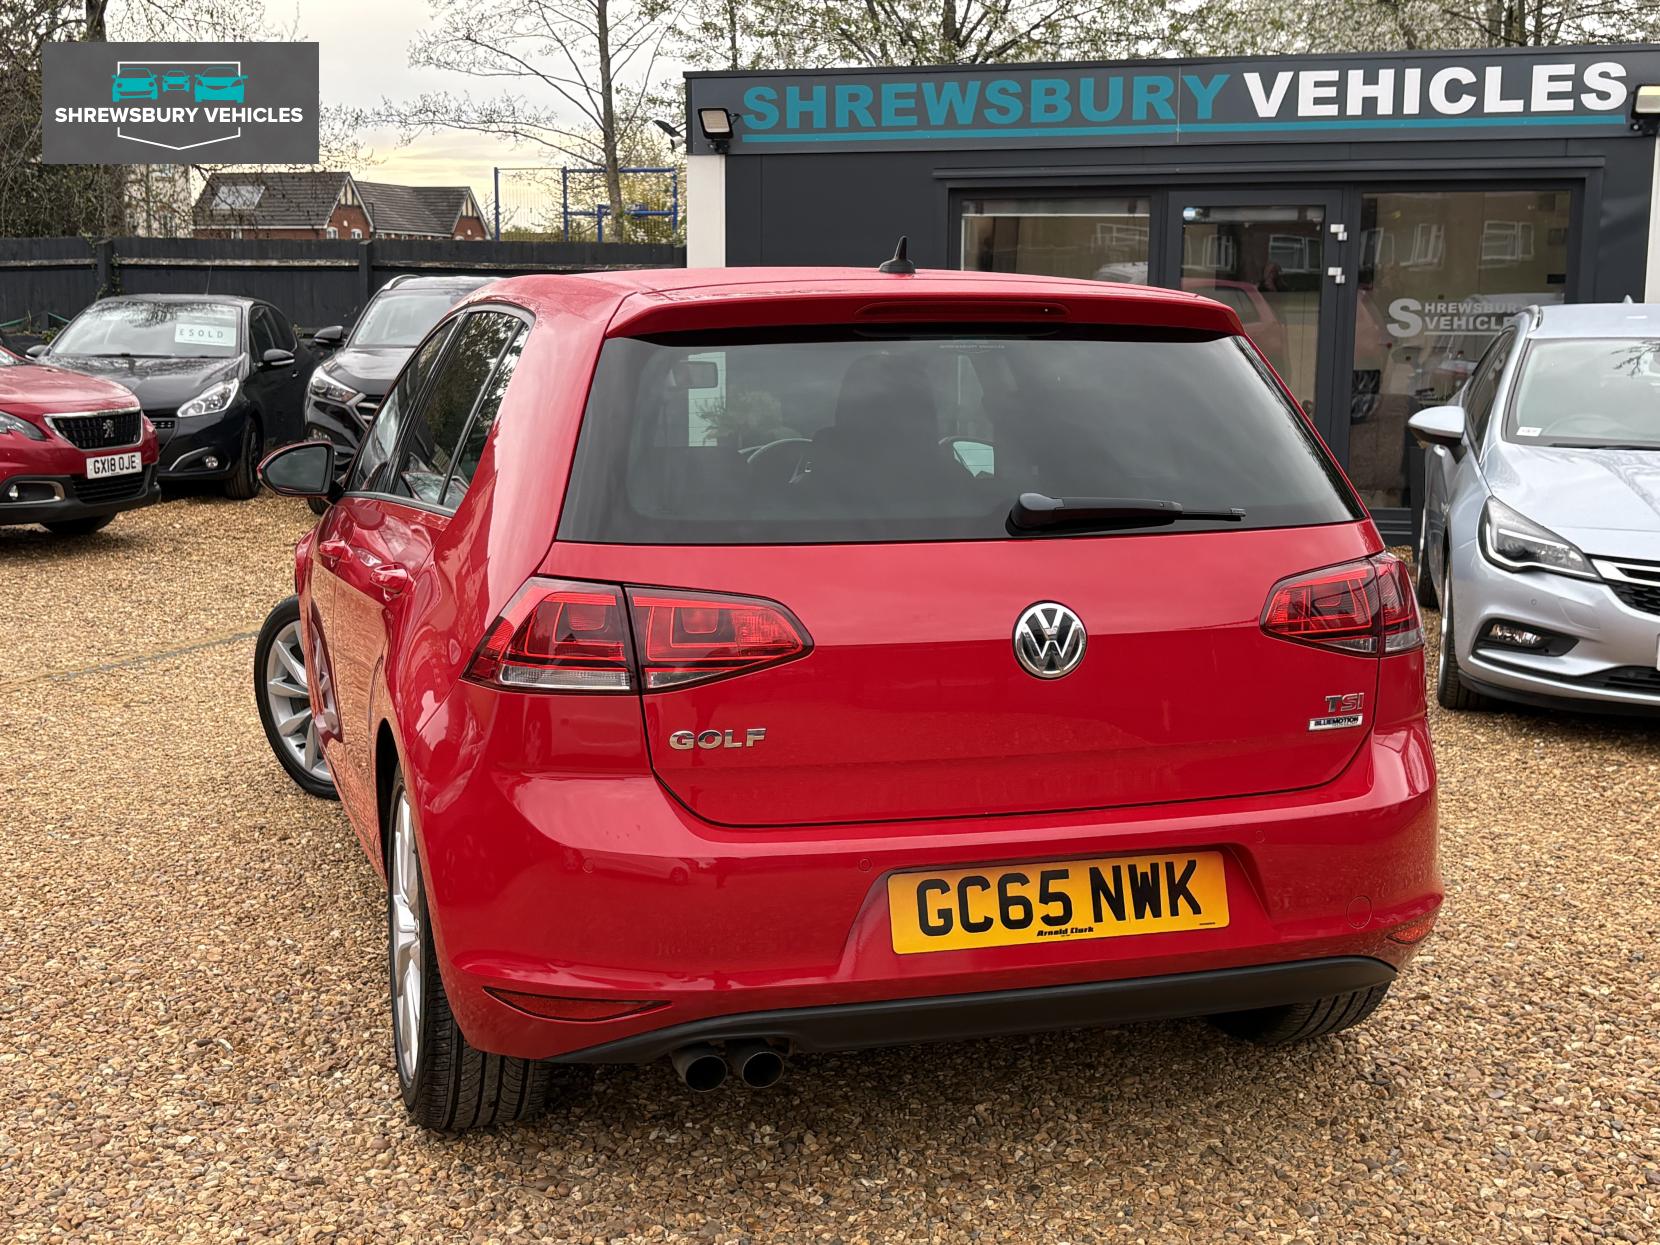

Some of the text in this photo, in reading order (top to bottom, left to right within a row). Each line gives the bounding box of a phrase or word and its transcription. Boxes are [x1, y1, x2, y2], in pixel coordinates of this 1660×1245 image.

[743, 62, 1628, 130] SHREWSBURY VEHICLES
[93, 457, 117, 475] GX18
[1325, 692, 1364, 712] TSI
[669, 728, 767, 750] GOLF
[916, 859, 1202, 937] GC65 NWK
[1037, 926, 1094, 937] Arnold Clark
